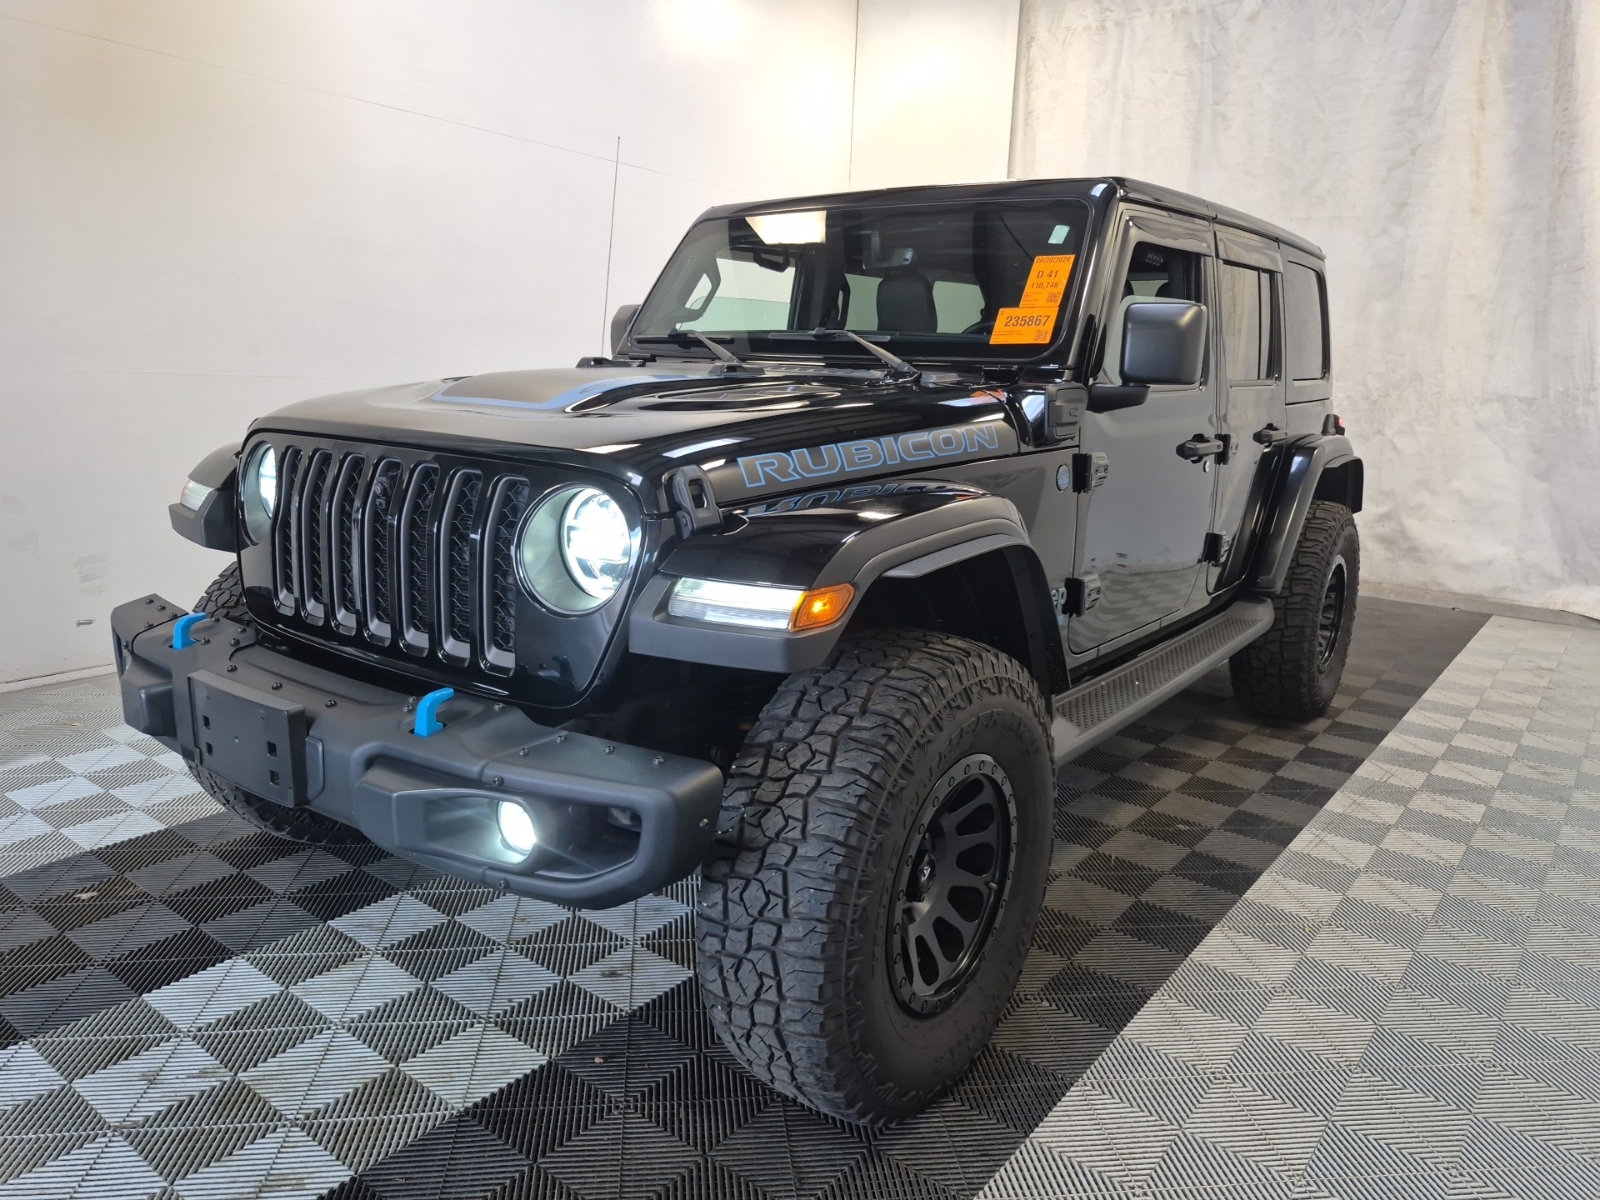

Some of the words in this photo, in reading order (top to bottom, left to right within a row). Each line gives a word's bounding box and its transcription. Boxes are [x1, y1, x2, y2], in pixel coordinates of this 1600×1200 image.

[1037, 270, 1044, 278] D
[1047, 270, 1059, 278] 41
[1004, 315, 1051, 327] 235867
[737, 424, 999, 488] RUBICON
